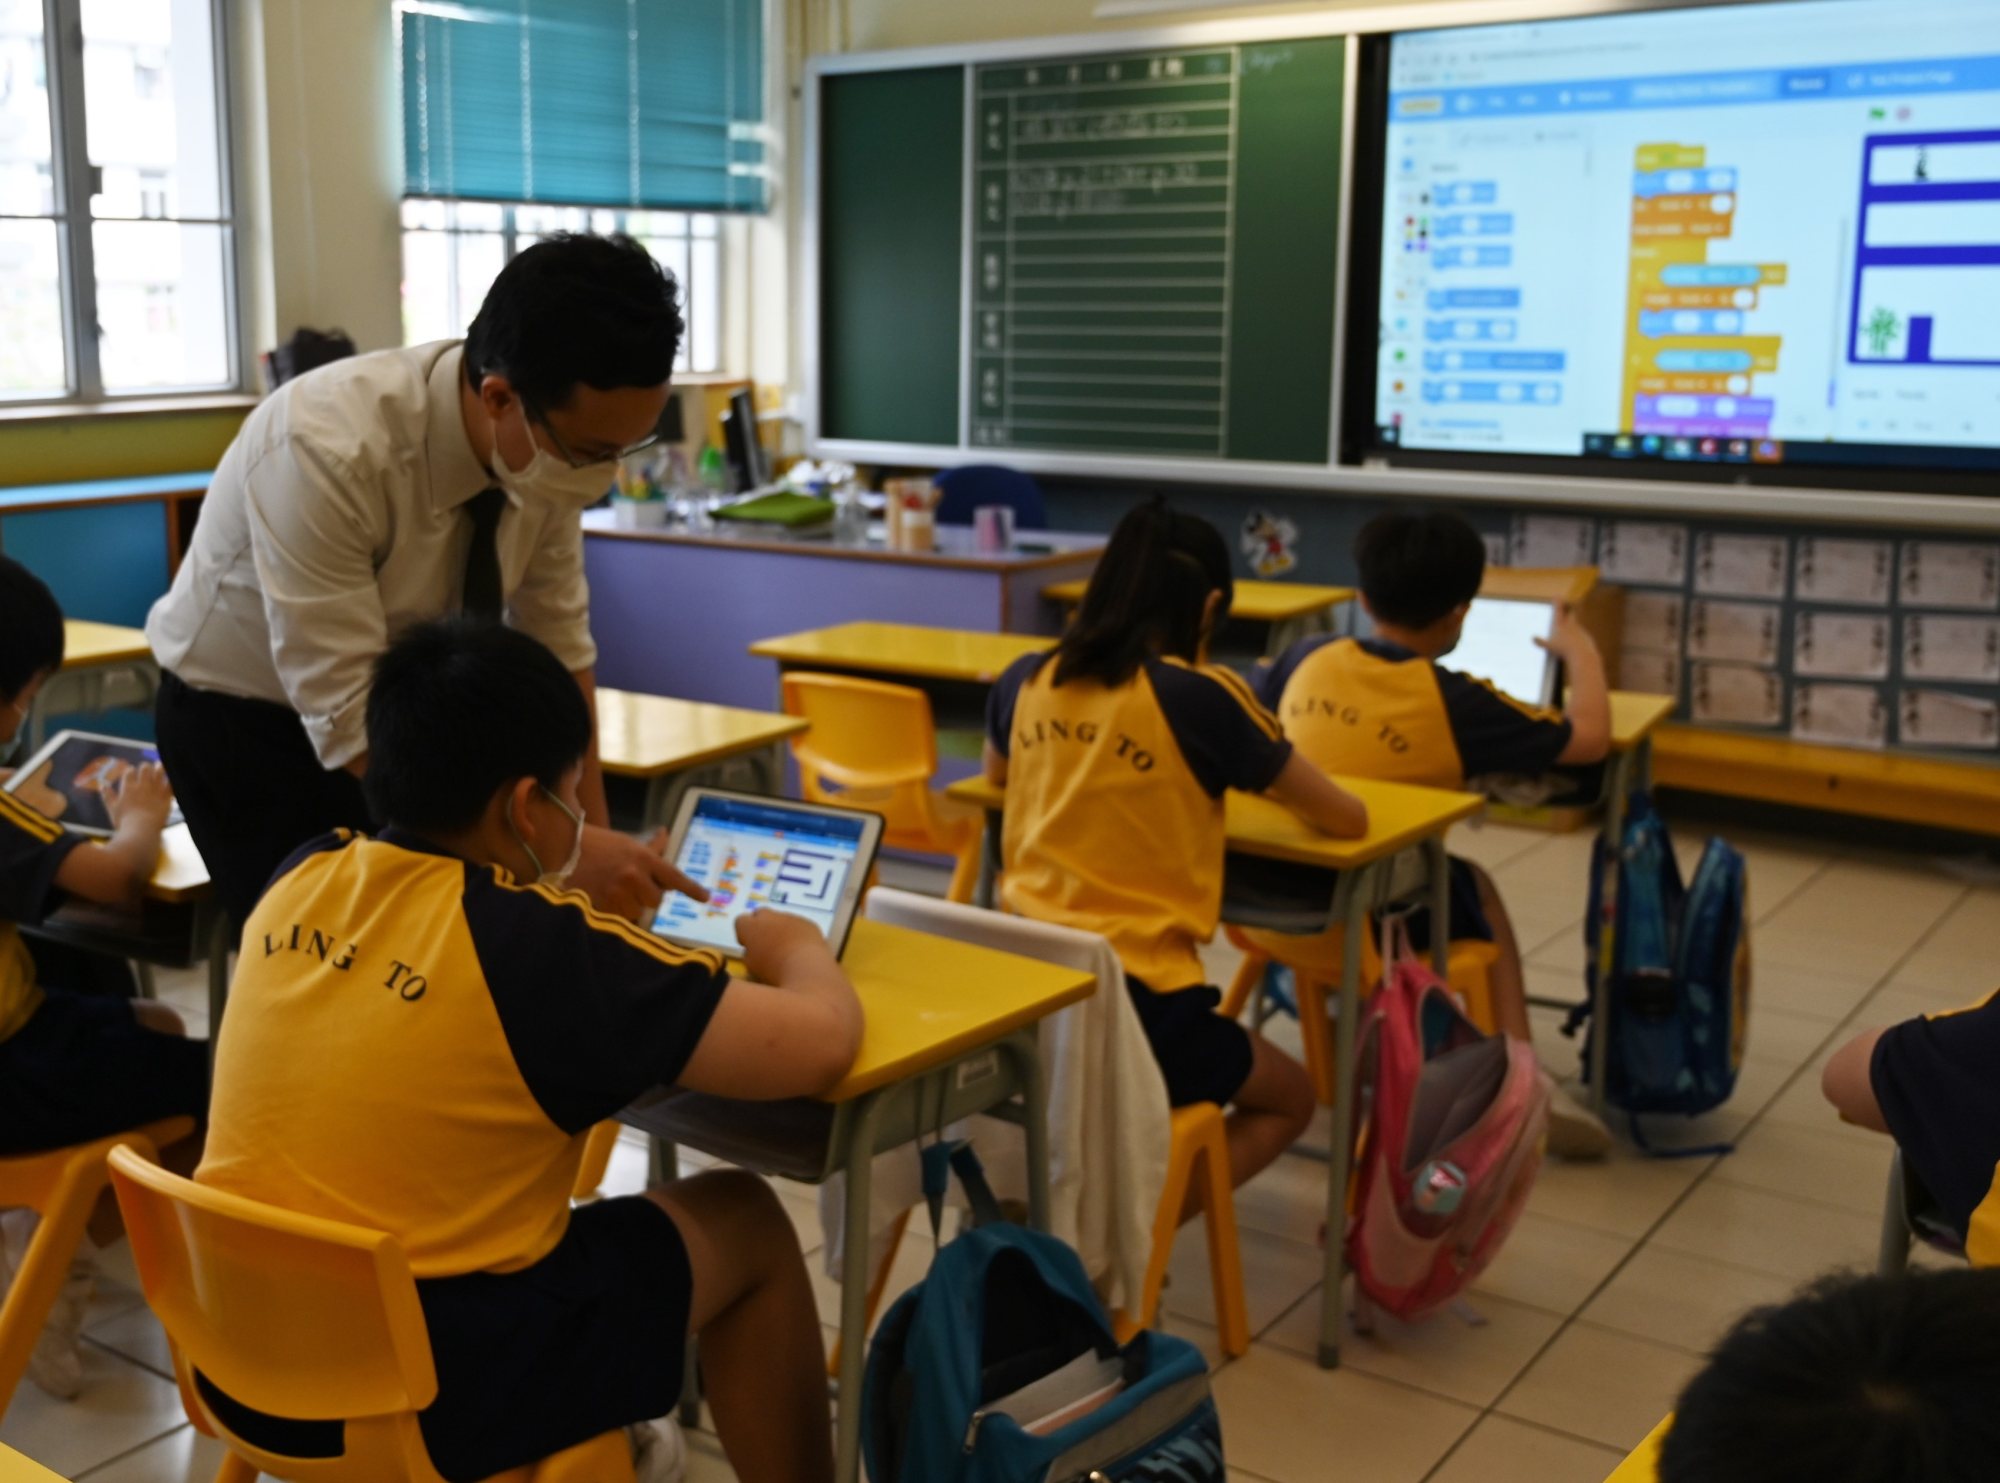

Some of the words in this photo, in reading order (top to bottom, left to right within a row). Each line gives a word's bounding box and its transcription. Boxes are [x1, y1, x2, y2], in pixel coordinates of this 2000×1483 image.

[1289, 697, 1360, 728] LING
[1018, 718, 1099, 750] LING
[1115, 732, 1155, 773] TO
[263, 923, 359, 973] LING
[383, 959, 428, 1002] TO
